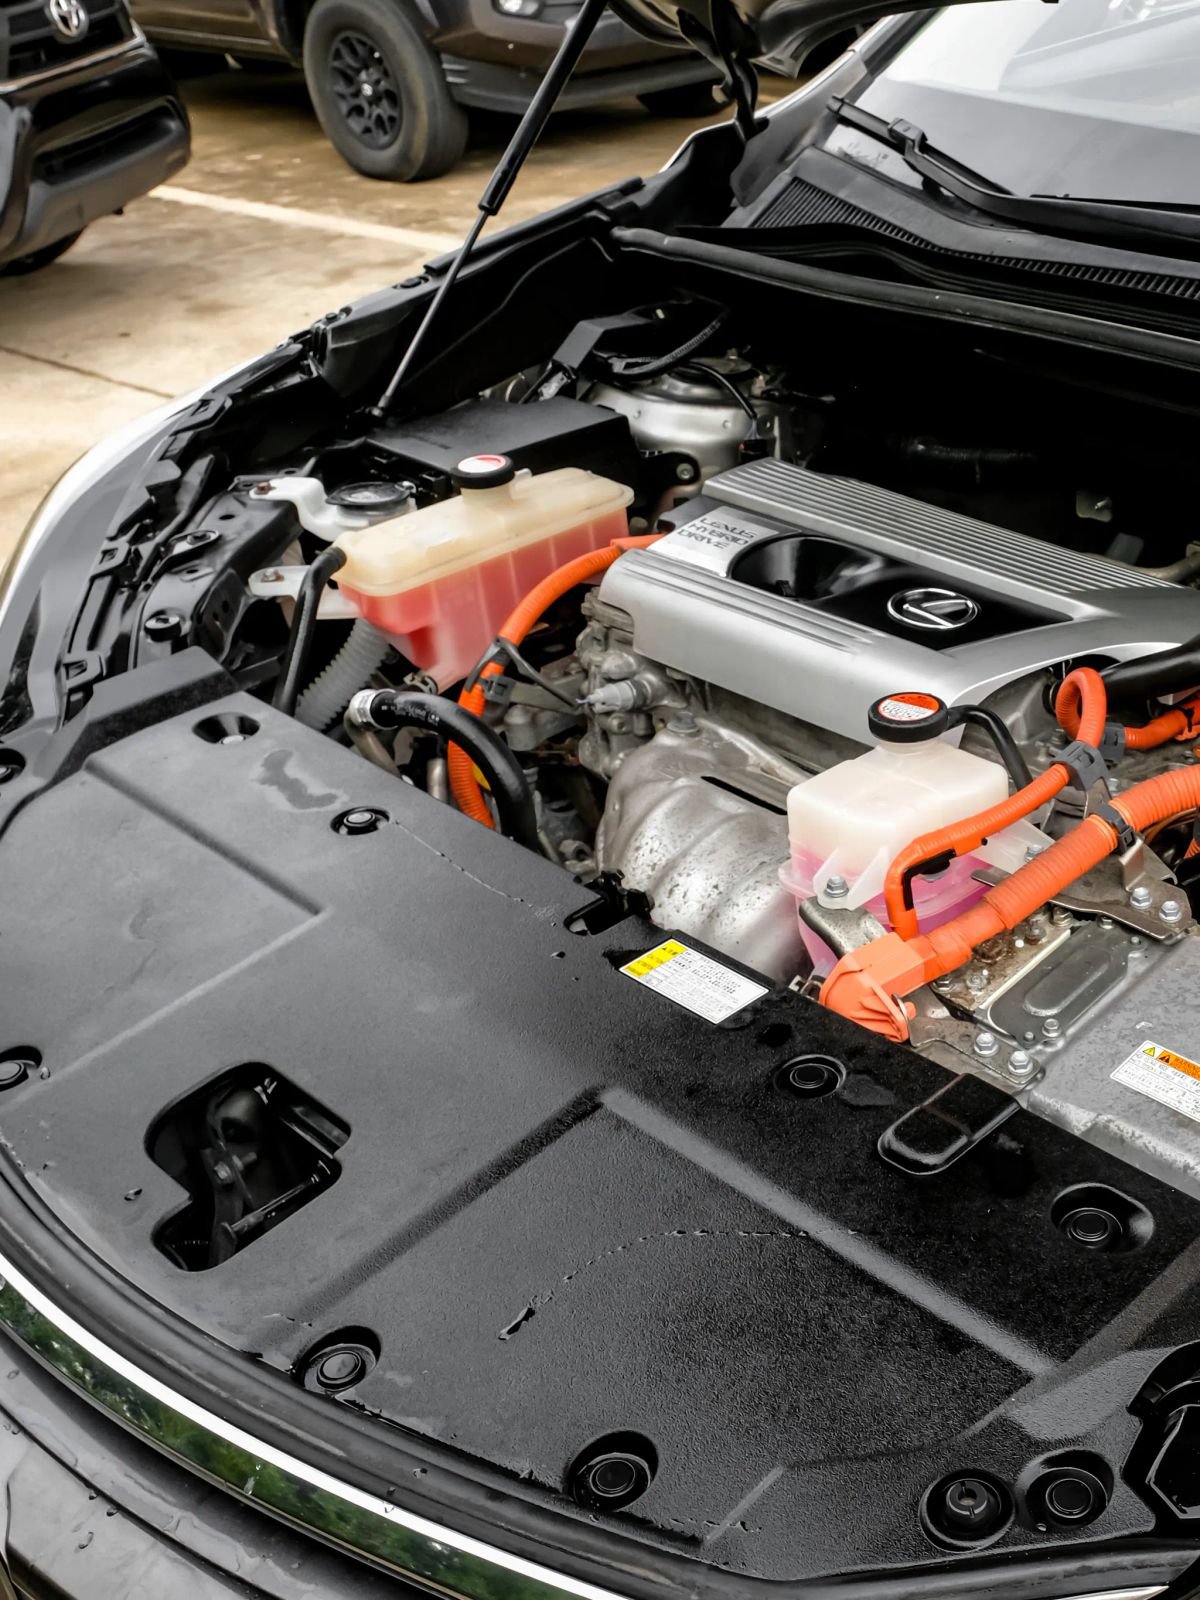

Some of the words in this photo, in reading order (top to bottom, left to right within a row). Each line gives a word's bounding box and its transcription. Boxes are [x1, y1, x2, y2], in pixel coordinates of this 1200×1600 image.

[688, 524, 749, 546] HYBRID
[700, 518, 757, 539] LEXUS
[678, 530, 730, 549] DRIVE
